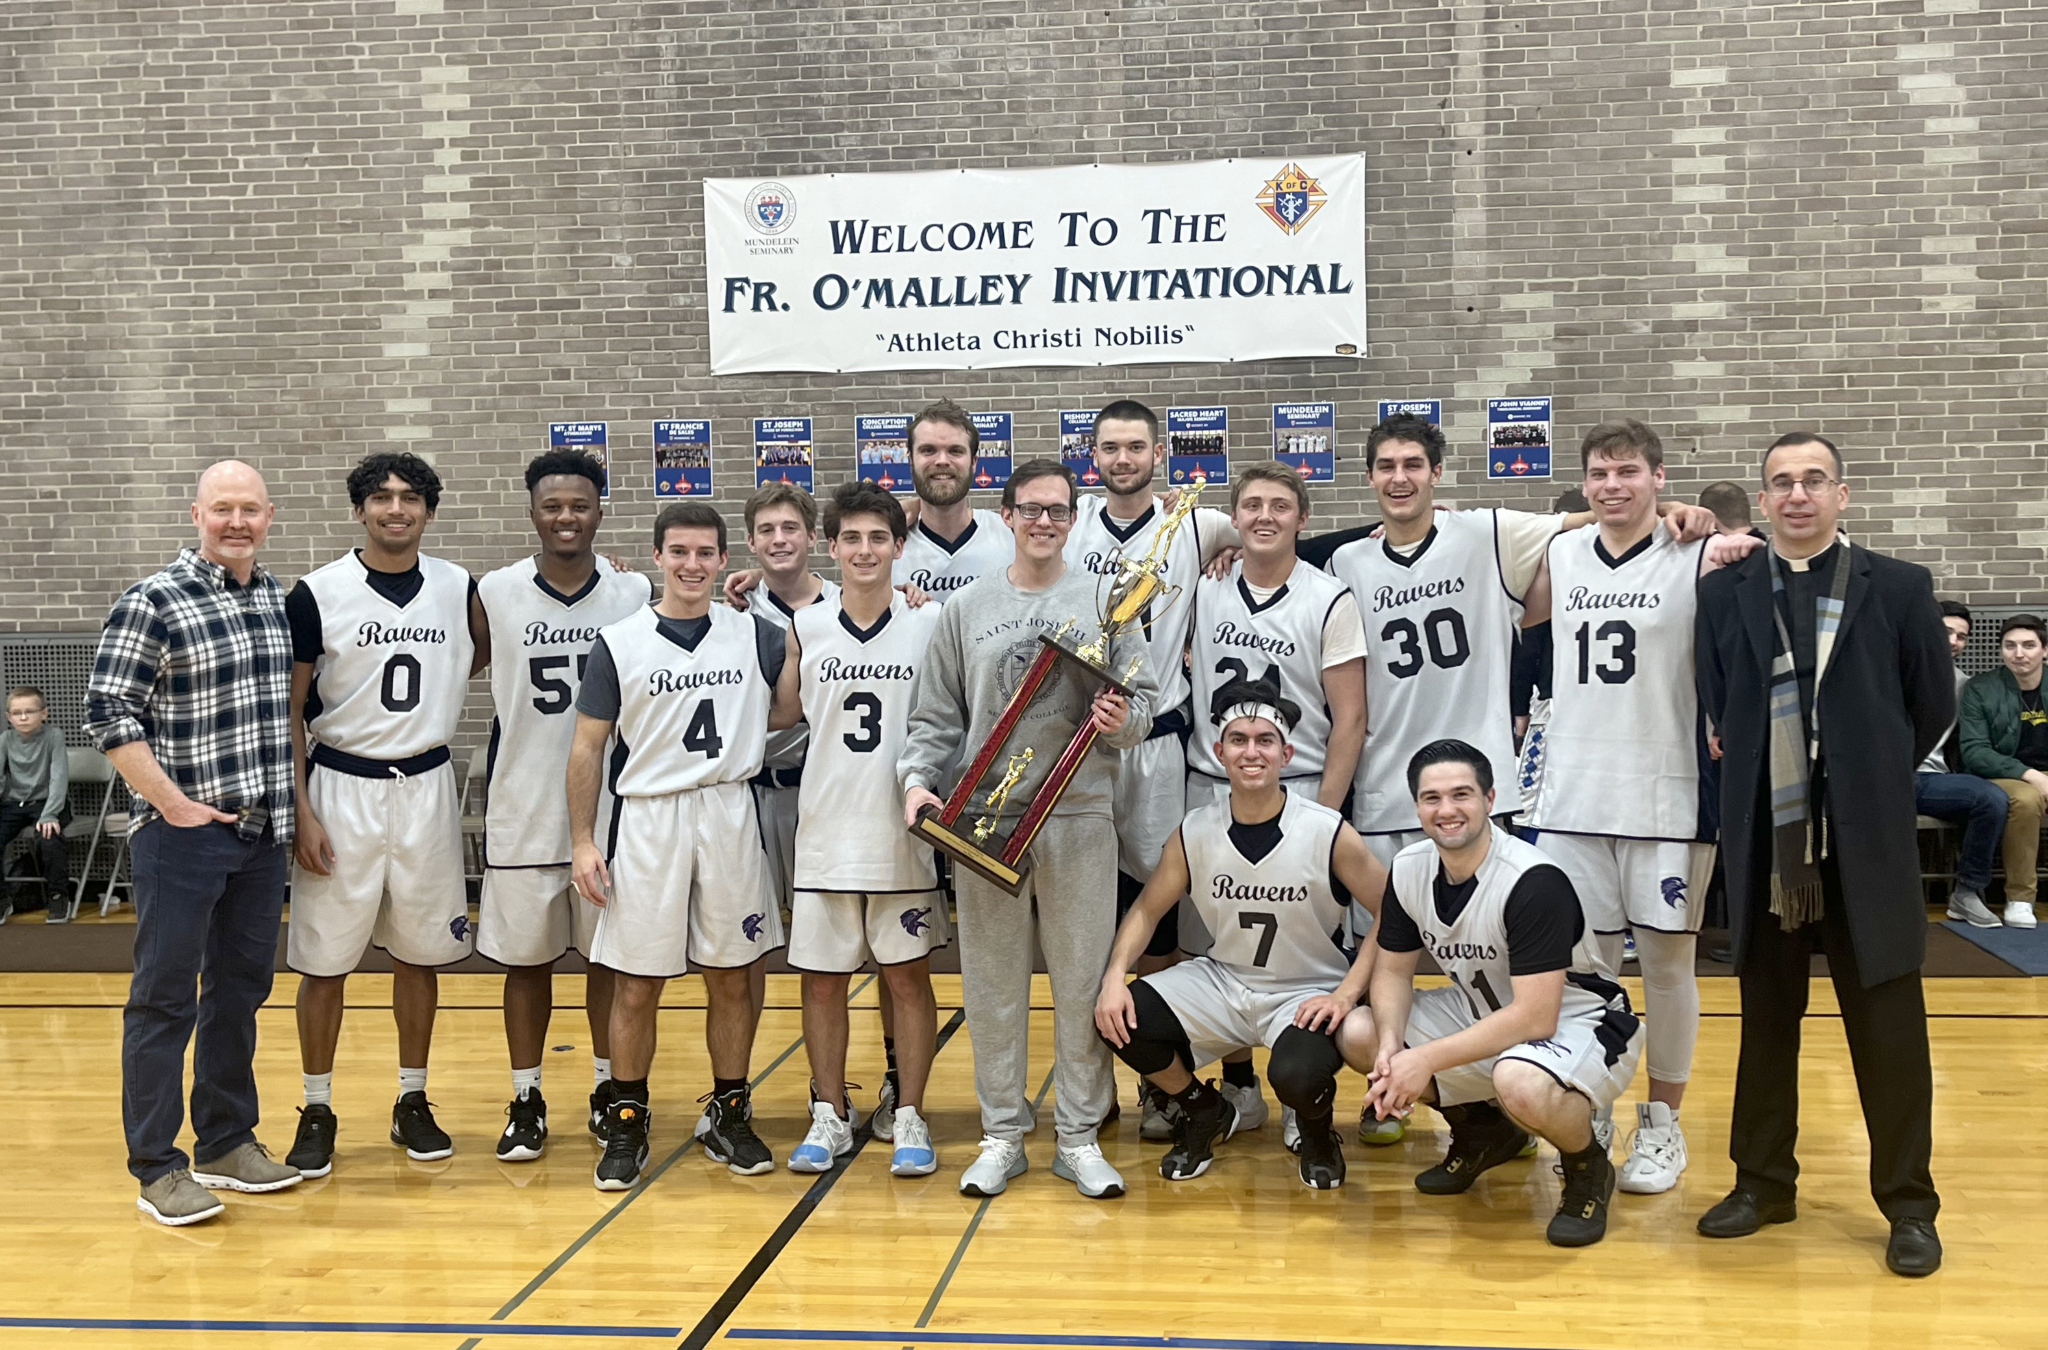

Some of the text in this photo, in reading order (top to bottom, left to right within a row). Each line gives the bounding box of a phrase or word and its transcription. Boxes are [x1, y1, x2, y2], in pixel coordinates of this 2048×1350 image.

[1275, 181, 1283, 191] K
[1300, 180, 1308, 190] C
[744, 237, 800, 247] MUNDELEIN
[828, 208, 1227, 255] WELCOME TO THE
[749, 246, 795, 256] SEMINARY
[721, 276, 791, 313] FR.
[1051, 262, 1353, 304] INVITATIONAL
[993, 327, 1082, 350] Christi
[973, 415, 1003, 423] MARY'S
[1278, 406, 1329, 414] MUNDELEIN
[1399, 403, 1432, 411] JOSEPH
[578, 424, 603, 432] MARYS
[1084, 551, 1169, 575] Ras
[910, 568, 980, 592] Rave
[1372, 576, 1465, 613] Ravens
[1565, 586, 1660, 612] Ravens
[356, 621, 446, 648] Ravens
[523, 621, 602, 646] Rave
[975, 617, 1086, 645] SAINT JOSEPH
[1212, 621, 1296, 657] Ravens
[1380, 606, 1471, 680] 30
[1575, 619, 1637, 685] 13
[380, 653, 422, 713] 0
[648, 668, 743, 697] Ravens
[819, 656, 914, 684] Ravens
[843, 691, 882, 753] 3
[1030, 705, 1069, 720] COLLEGE
[681, 698, 724, 760] 4
[1211, 874, 1308, 902] Ravens
[1238, 911, 1279, 968] 7
